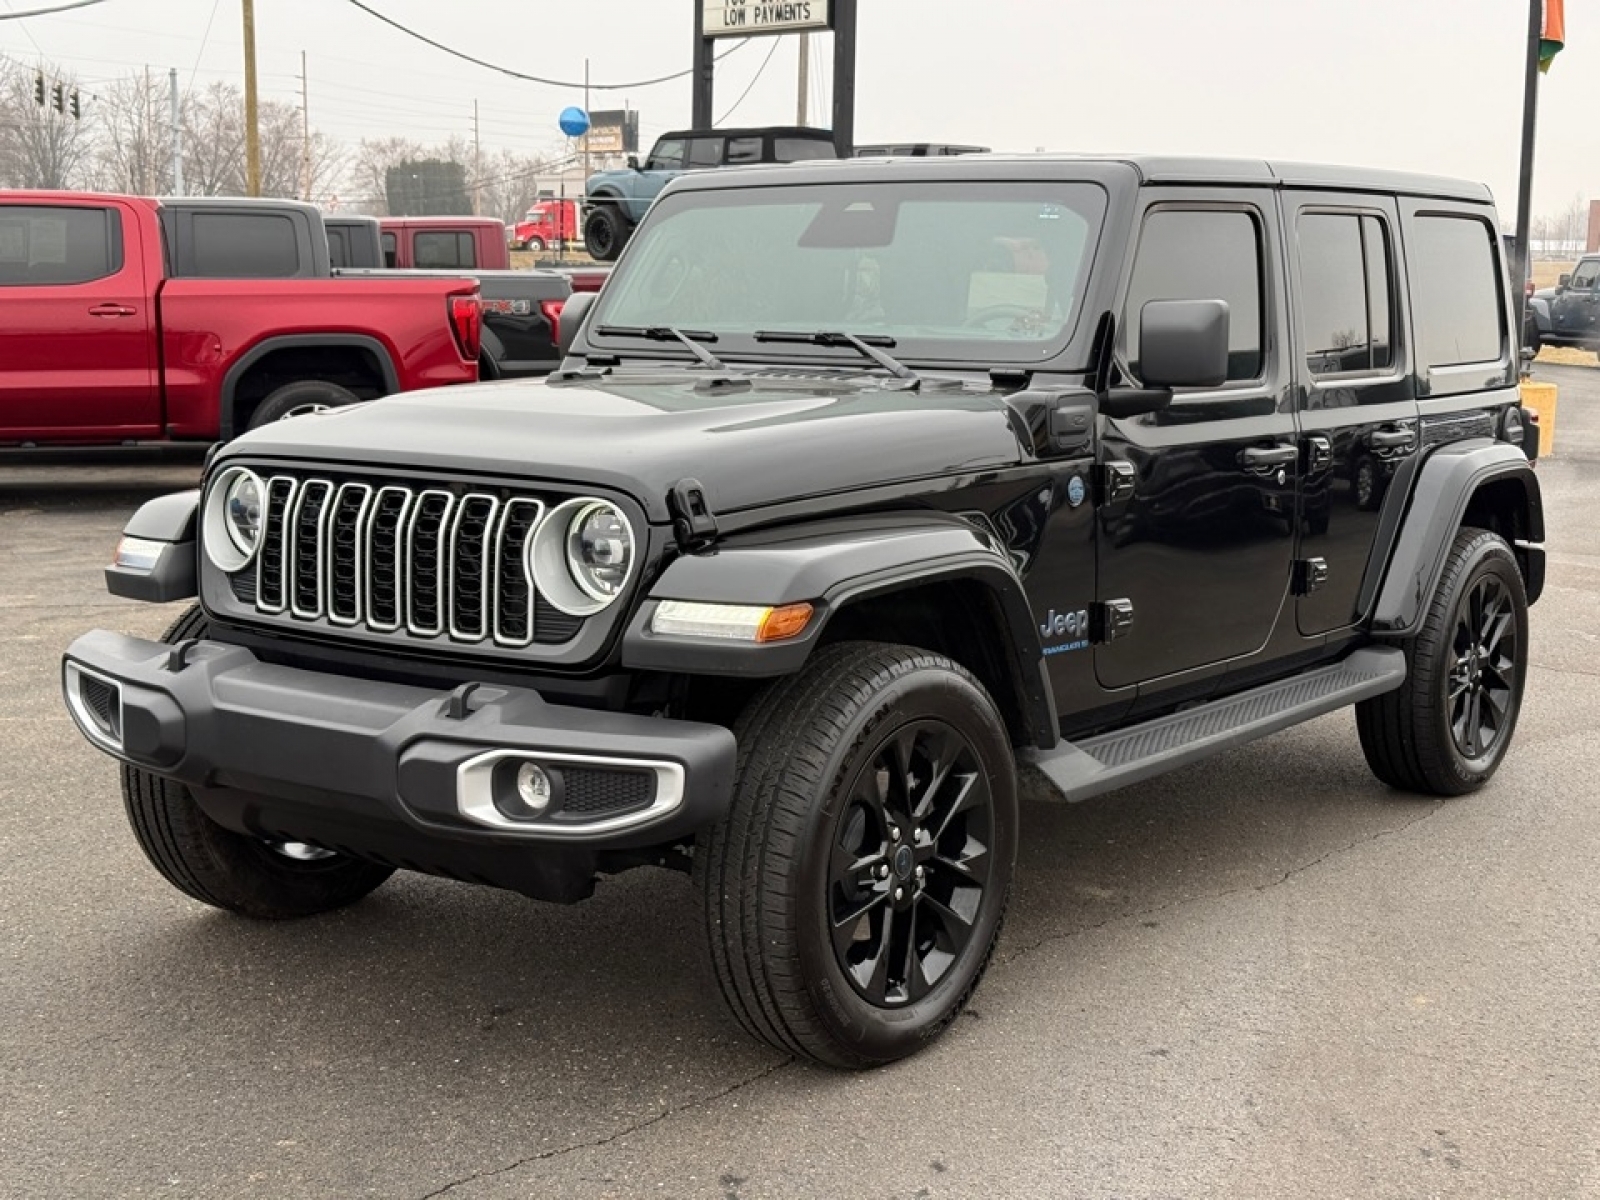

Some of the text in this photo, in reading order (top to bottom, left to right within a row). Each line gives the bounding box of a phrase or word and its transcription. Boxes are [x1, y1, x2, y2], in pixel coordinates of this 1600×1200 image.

[724, 1, 811, 26] LOW PAYMENTS
[1040, 609, 1089, 638] Jeep
